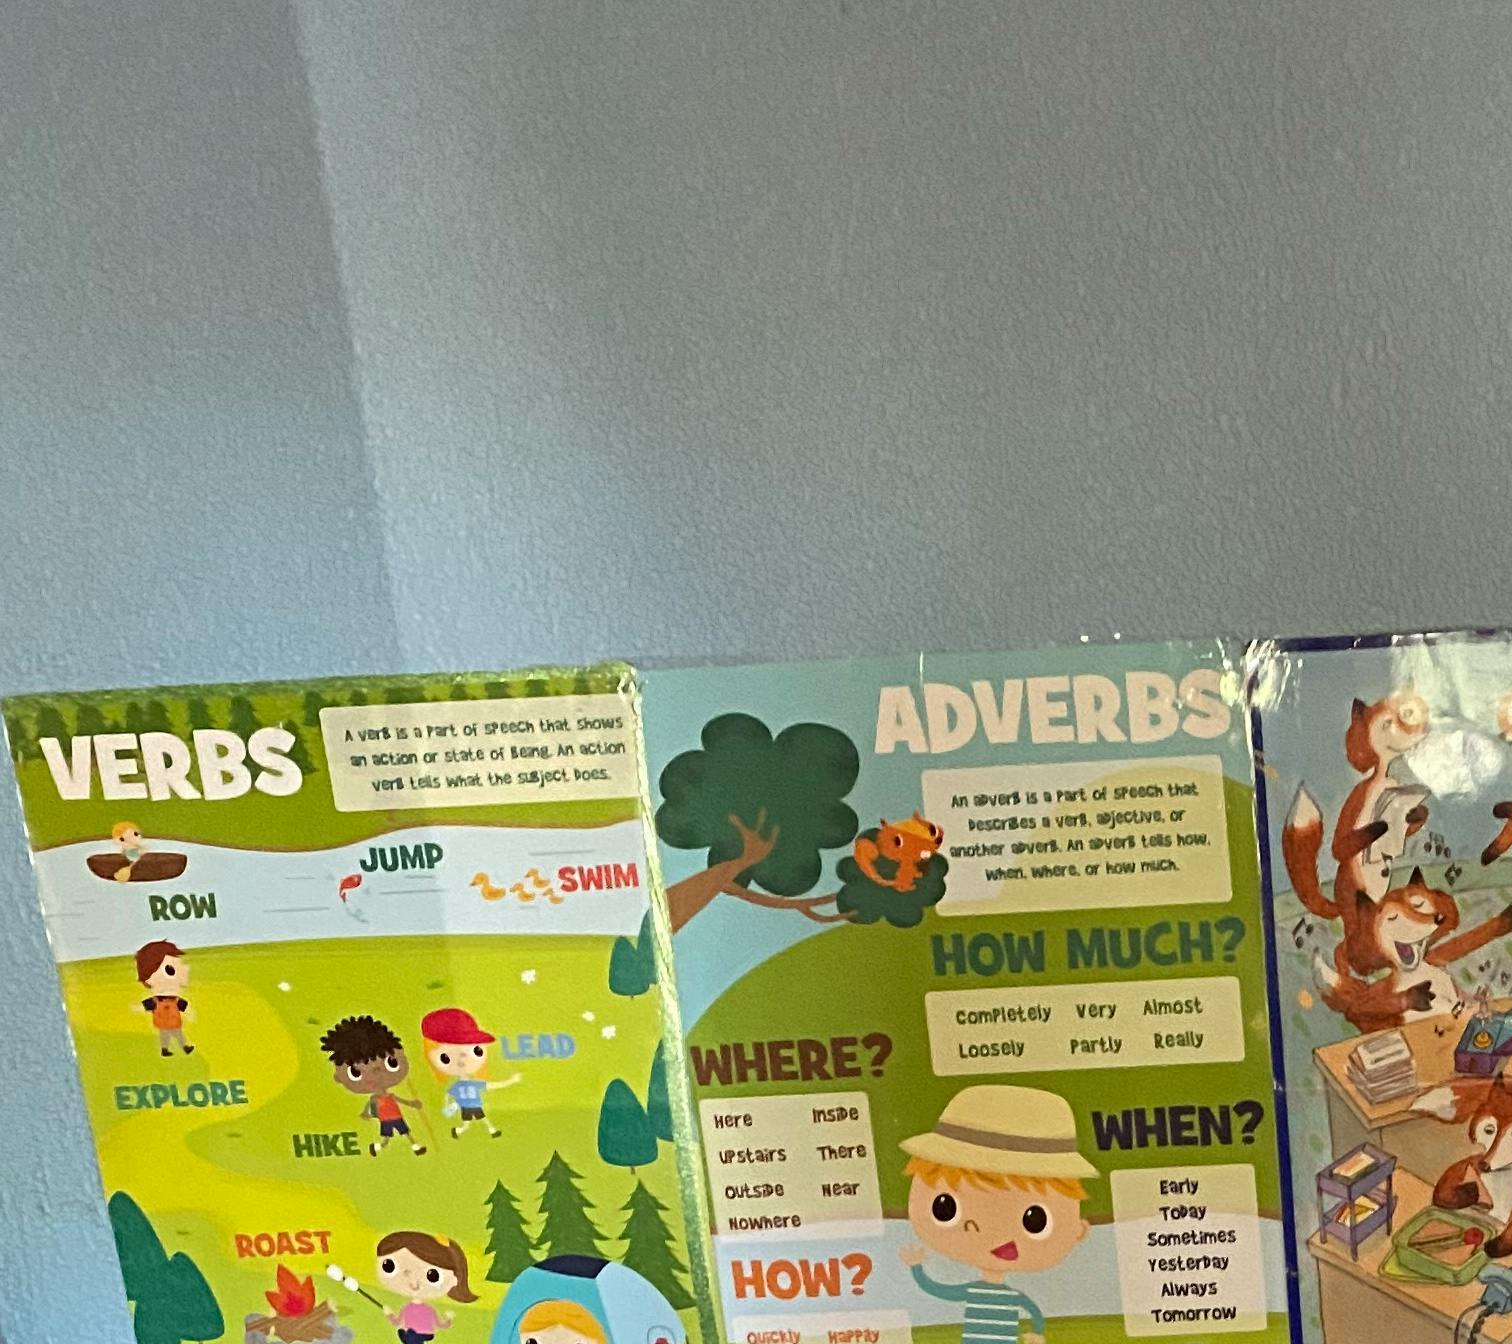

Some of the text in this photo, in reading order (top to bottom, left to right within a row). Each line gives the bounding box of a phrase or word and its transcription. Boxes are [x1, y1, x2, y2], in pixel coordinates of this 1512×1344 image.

[875, 668, 1232, 755] ADVERBS
[345, 716, 623, 741] A verb is a part of speech that shows
[39, 726, 303, 803] VERBS
[350, 741, 625, 767] an action or state of being. An action
[372, 767, 610, 792] verb tells what the subject does.
[951, 782, 1199, 808] An adverb is a part of speech that
[359, 842, 444, 874] JUMP
[557, 863, 640, 893] SWIM
[149, 893, 218, 923] ROW
[932, 916, 1246, 978] HOW MUCH?
[955, 996, 1203, 1027] Completely Very Almost
[500, 1032, 577, 1060] LEAD
[959, 1028, 1204, 1060] Loosely Partly Really
[689, 1033, 893, 1087] WHERE?
[114, 1080, 249, 1111] EXPLORE
[1092, 1099, 1264, 1150] WHEN?
[293, 1132, 362, 1160] HIKE
[235, 1231, 332, 1258] ROAST
[731, 1253, 873, 1300] HOW?
